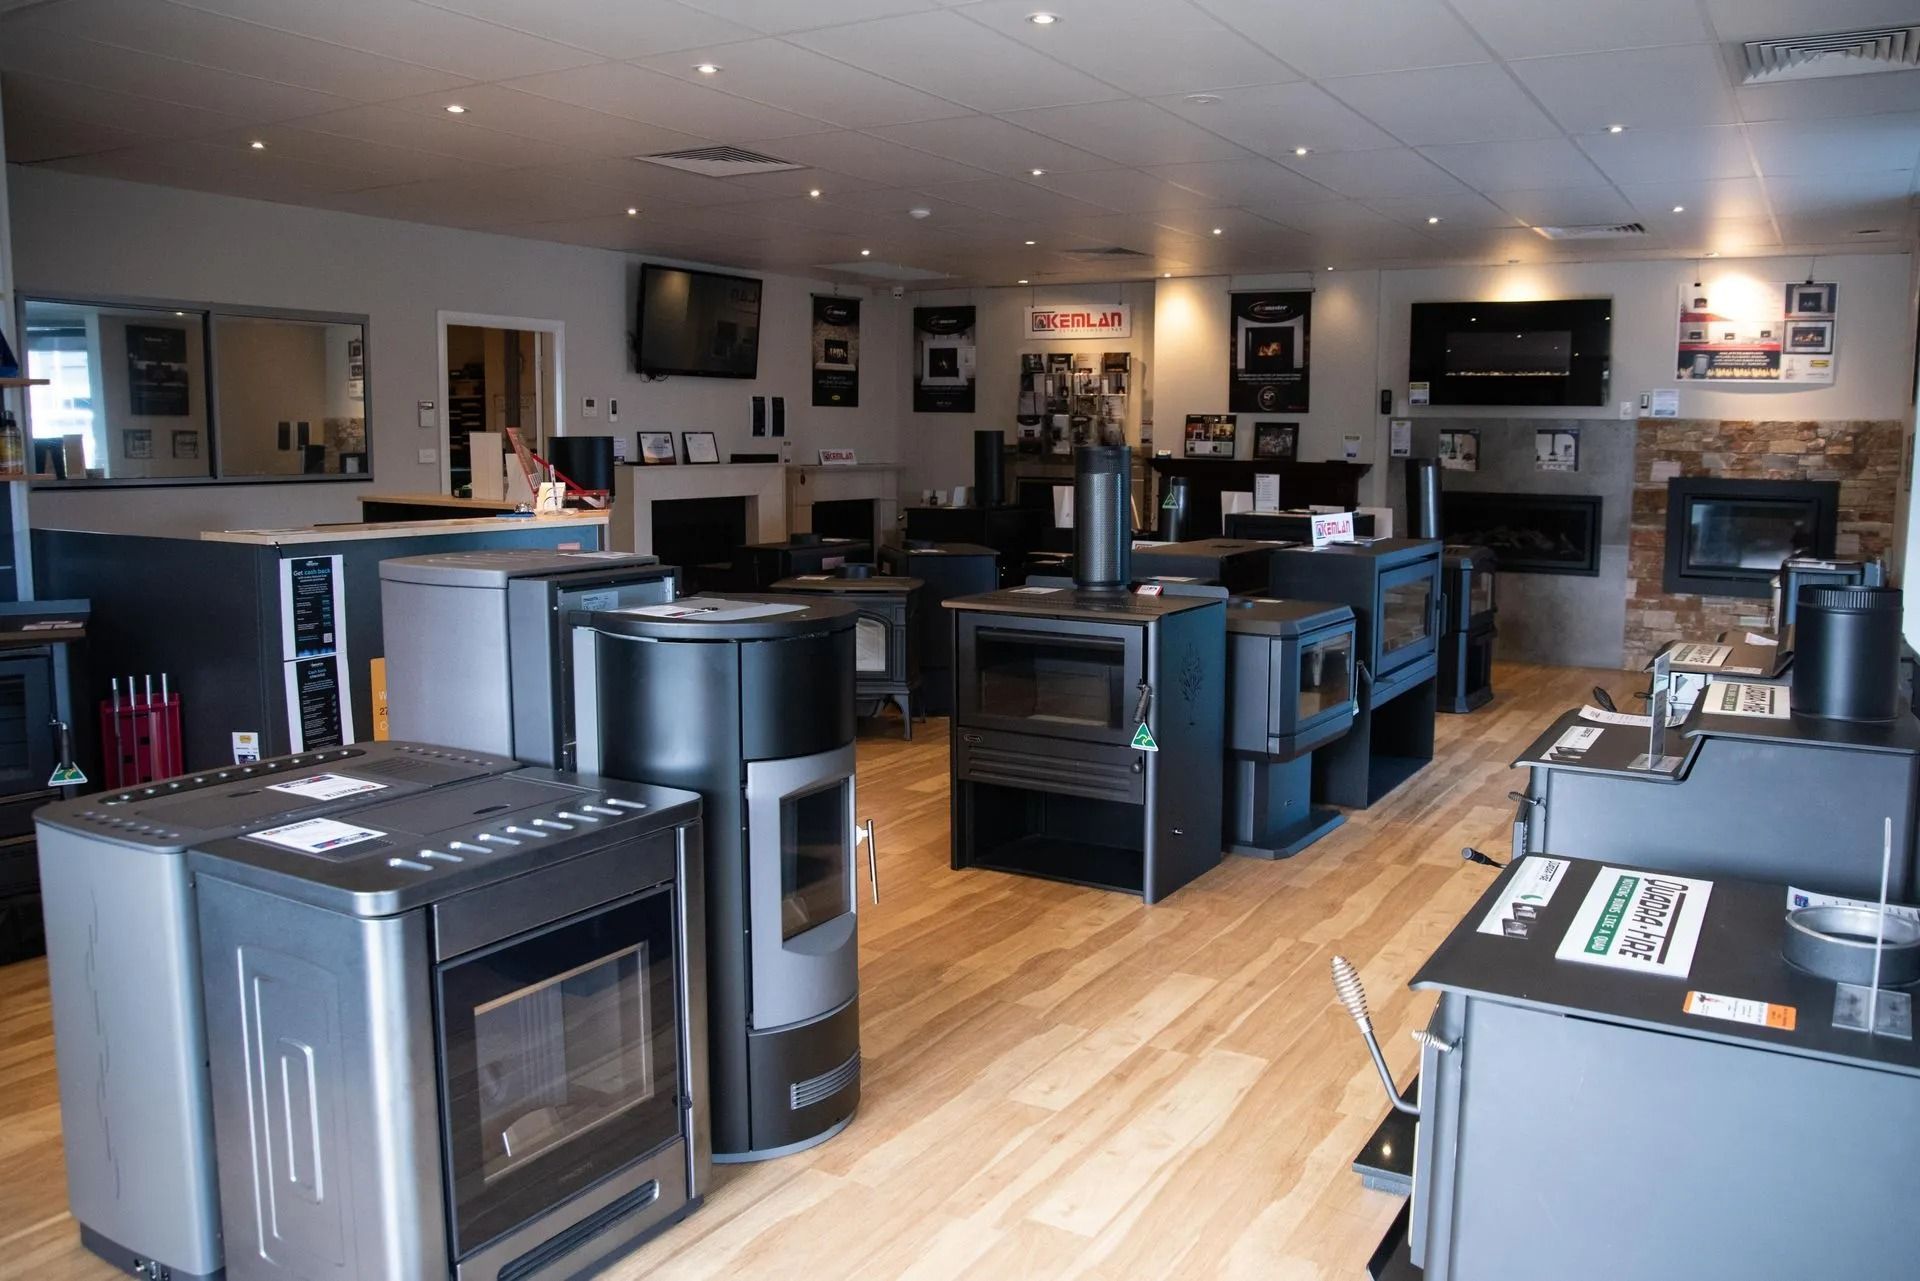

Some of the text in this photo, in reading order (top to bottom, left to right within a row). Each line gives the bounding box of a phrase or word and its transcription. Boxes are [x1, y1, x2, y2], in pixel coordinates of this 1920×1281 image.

[1046, 312, 1122, 329] KEMLAN
[1322, 520, 1351, 536] KEMLAN
[1601, 914, 1618, 929] LIKE
[1591, 935, 1609, 951] QUAD
